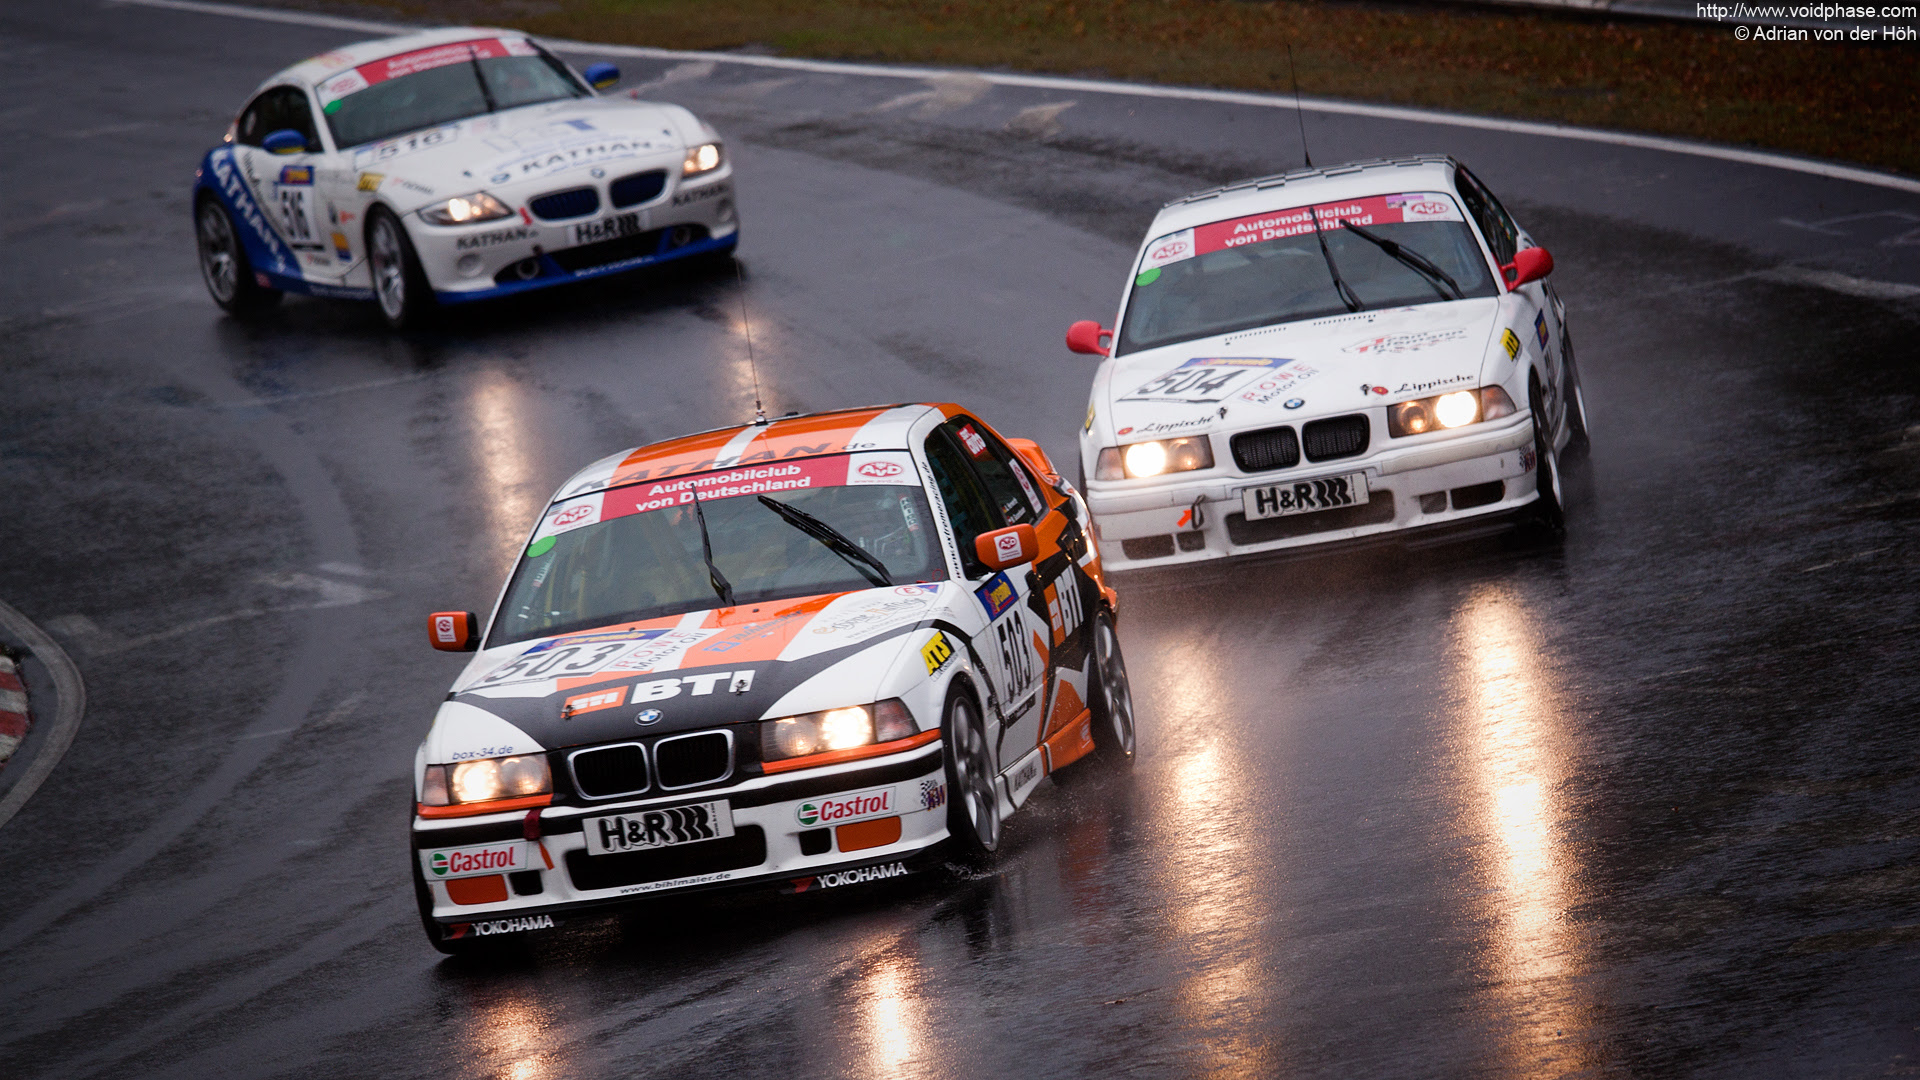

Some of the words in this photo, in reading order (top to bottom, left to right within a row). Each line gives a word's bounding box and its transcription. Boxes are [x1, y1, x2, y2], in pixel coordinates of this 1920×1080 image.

[1224, 230, 1258, 248] von
[1262, 214, 1373, 240] Deutschland
[1233, 204, 1362, 235] Automobilclub
[1137, 368, 1248, 395] 504
[1257, 378, 1297, 405] Motor
[1394, 374, 1474, 394] Lippische
[1136, 415, 1214, 434] Lippische
[635, 498, 674, 512] von
[679, 476, 811, 504] Deutschland
[648, 465, 801, 496] Automobilclub
[484, 643, 626, 682] 503
[615, 631, 691, 668] ROWE
[632, 645, 682, 670] Motor
[683, 632, 709, 645] Oil
[997, 610, 1031, 704] 503
[630, 670, 756, 704] BTI
[452, 744, 514, 760] box-34.de
[820, 791, 889, 821] Castrol
[450, 846, 515, 873] Castrol
[620, 872, 731, 895] www.bihlmaier.de
[816, 862, 908, 888] YOKOHAMA
[471, 914, 554, 936] YOKOHAMA
